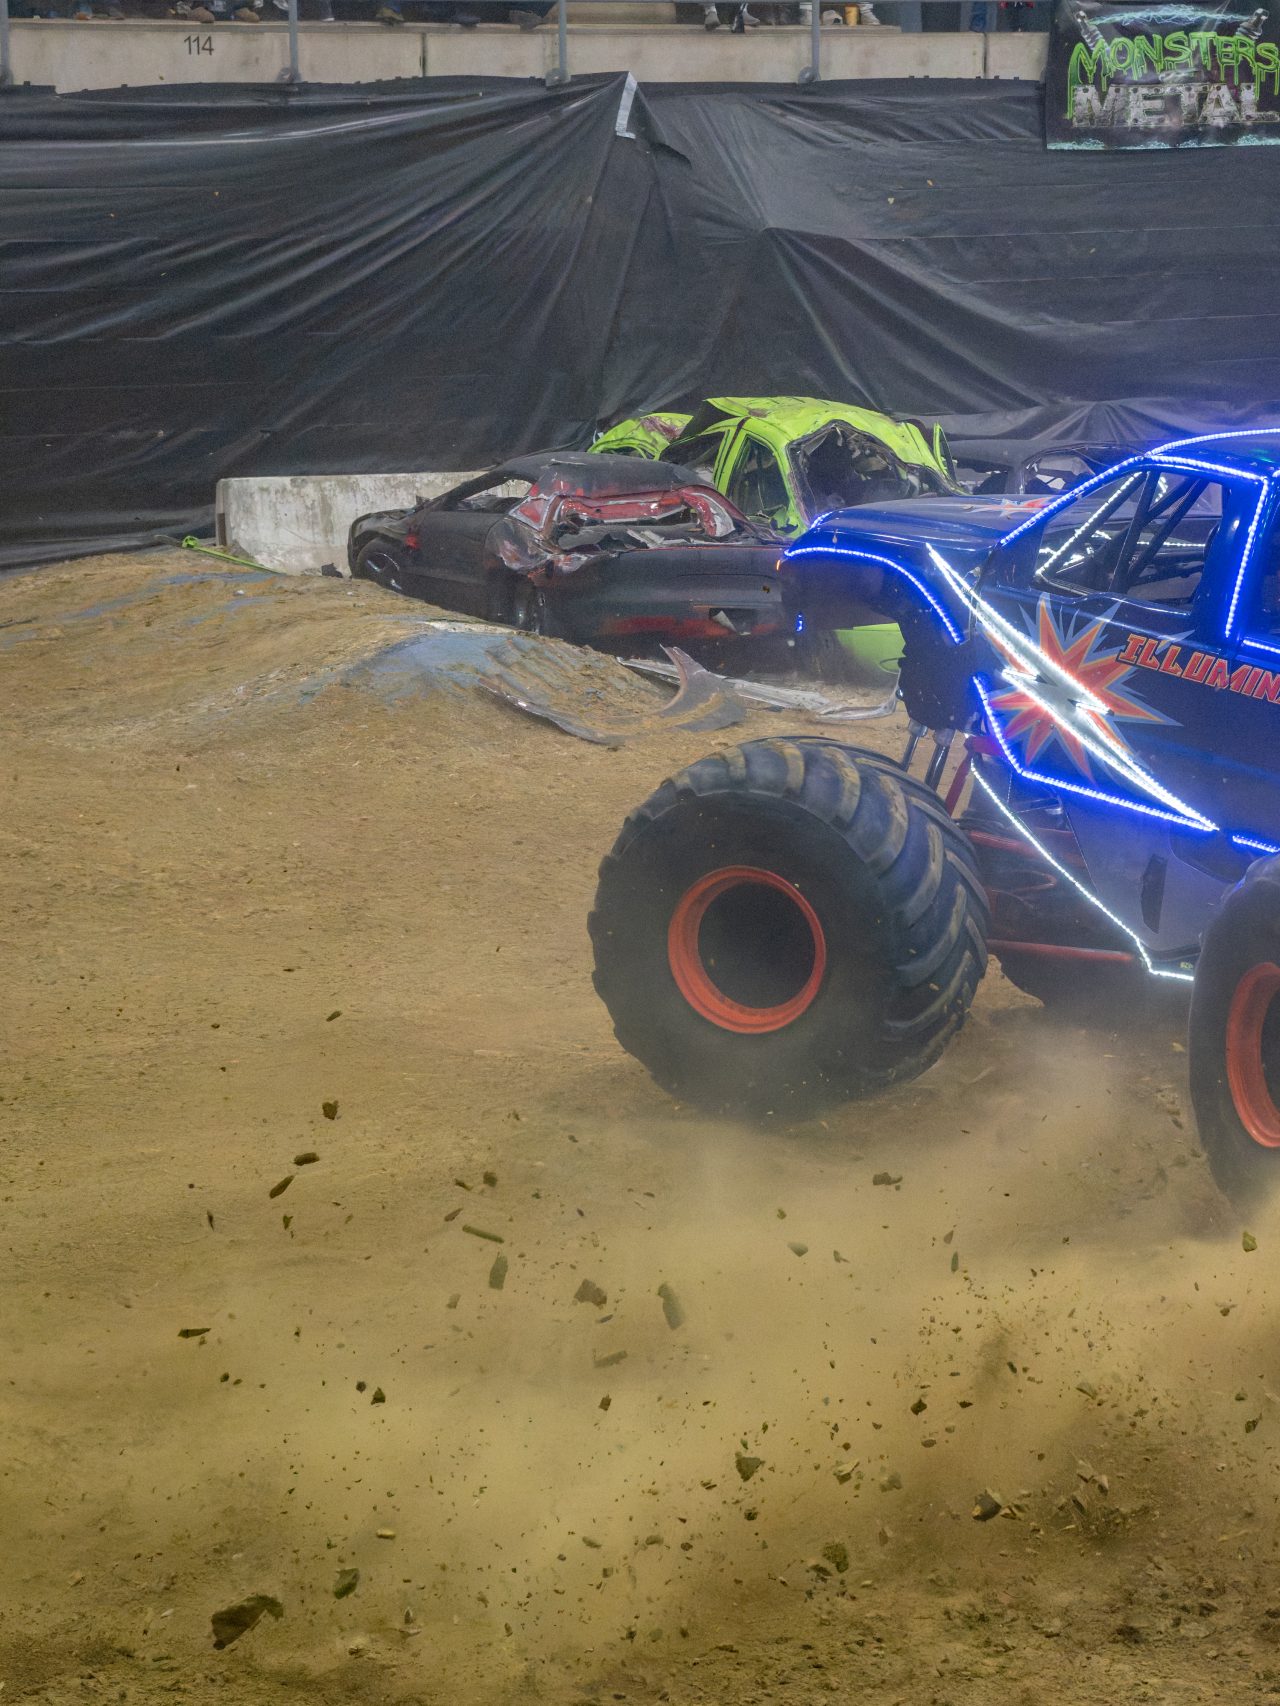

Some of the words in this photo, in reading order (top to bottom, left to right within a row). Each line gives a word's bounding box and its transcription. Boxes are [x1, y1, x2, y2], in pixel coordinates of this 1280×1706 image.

[183, 35, 215, 56] 114
[1067, 31, 1280, 103] MONSTERS
[1072, 83, 1280, 128] METAL
